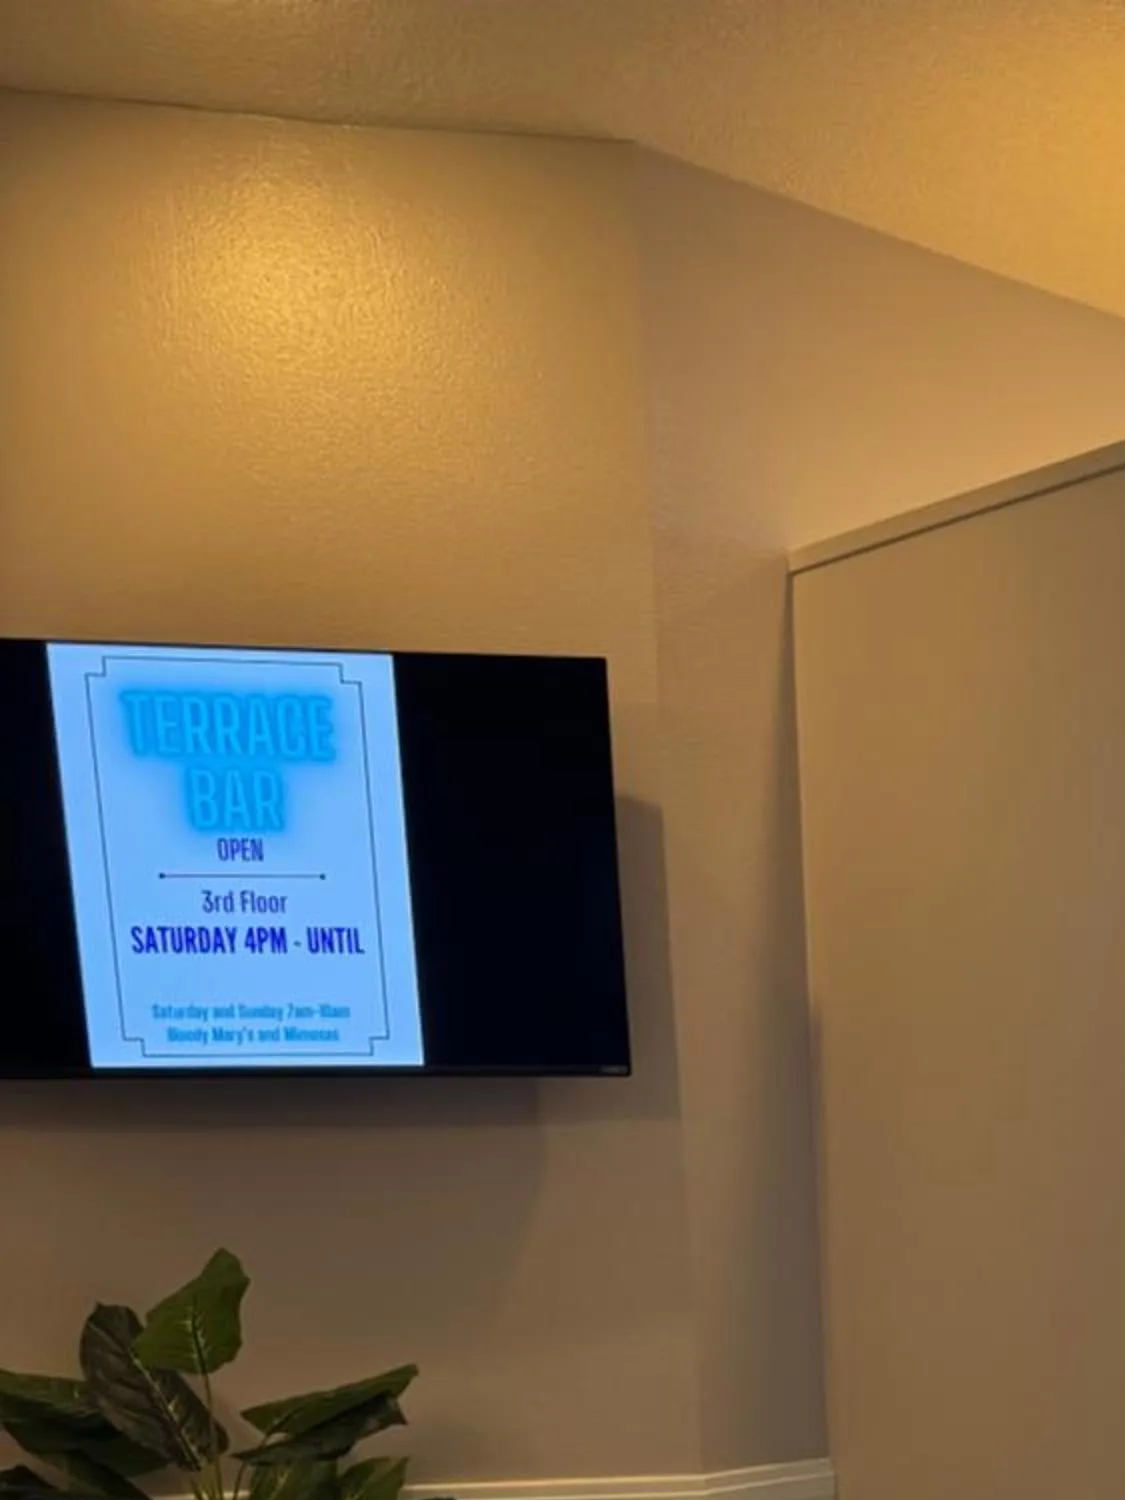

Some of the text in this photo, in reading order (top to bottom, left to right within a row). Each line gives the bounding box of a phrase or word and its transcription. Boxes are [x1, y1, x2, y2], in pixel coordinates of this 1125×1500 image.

[122, 695, 334, 757] TERRACE
[188, 769, 283, 829] BAR
[217, 837, 264, 862] OPEN
[202, 889, 287, 914] 3rd Floor
[131, 925, 237, 954] SATURDAY
[244, 926, 288, 954] 4PM
[307, 926, 366, 955] UNTIL
